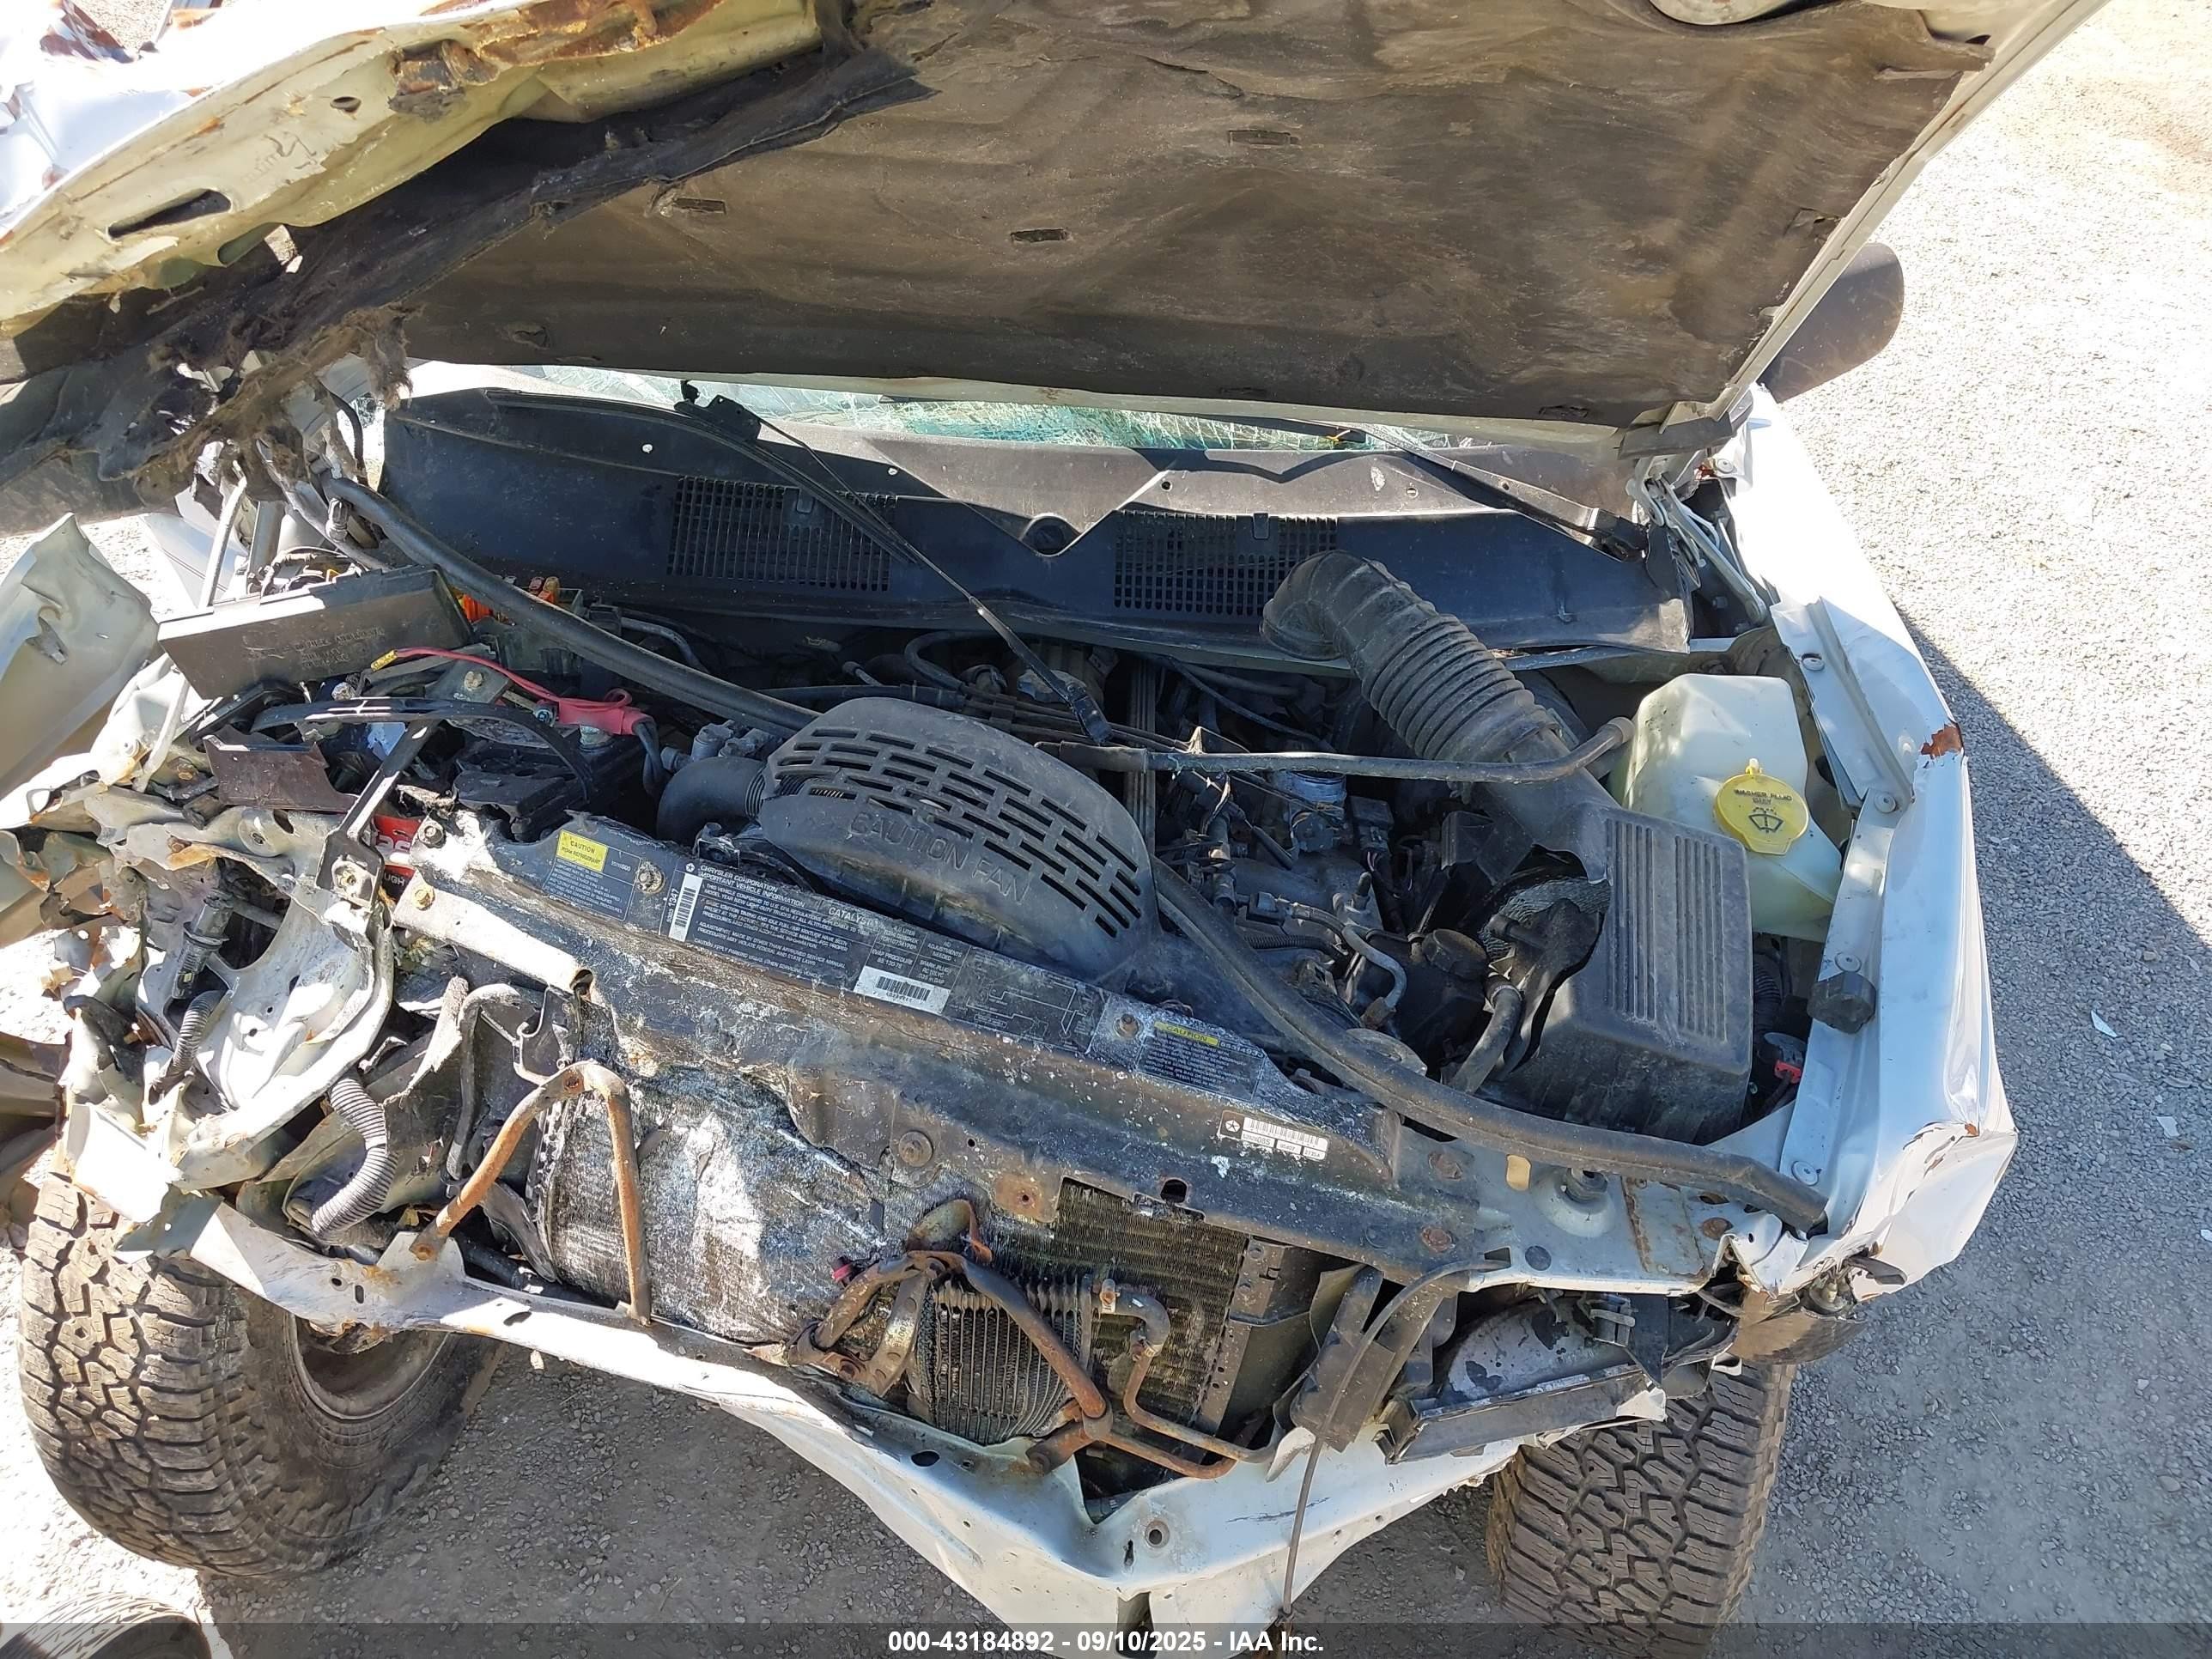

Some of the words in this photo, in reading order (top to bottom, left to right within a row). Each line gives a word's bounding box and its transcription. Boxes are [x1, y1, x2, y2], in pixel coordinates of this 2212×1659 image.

[1735, 789, 1767, 798] WASHER
[569, 840, 595, 854] CAUTION
[848, 811, 969, 872] CAUTION
[972, 859, 1030, 906] FAN
[700, 864, 733, 879] CHRYSLER
[733, 874, 778, 892] CORPORATION
[697, 870, 735, 886] IMPORTANT
[735, 881, 762, 894] VEHICLE
[762, 890, 805, 908] INFORMATION
[668, 887, 679, 908] 1347
[703, 888, 720, 897] MODEL
[772, 908, 791, 919] TRUCKS
[716, 886, 736, 896] VEHICLE
[789, 908, 822, 921] REGULATIONS
[821, 917, 849, 930] APPLICABLE
[701, 910, 732, 923] PROCEDURES
[821, 933, 834, 942] HAVE
[902, 927, 915, 936] LITER
[756, 944, 776, 954] FEDERAL
[787, 953, 801, 962] STATE
[768, 941, 781, 950] THAN
[781, 945, 806, 957] APPROVED
[927, 942, 963, 957] ADJUSTMENTS
[932, 951, 952, 961] NEEDED
[1165, 1025, 1208, 1042] CAUTION
